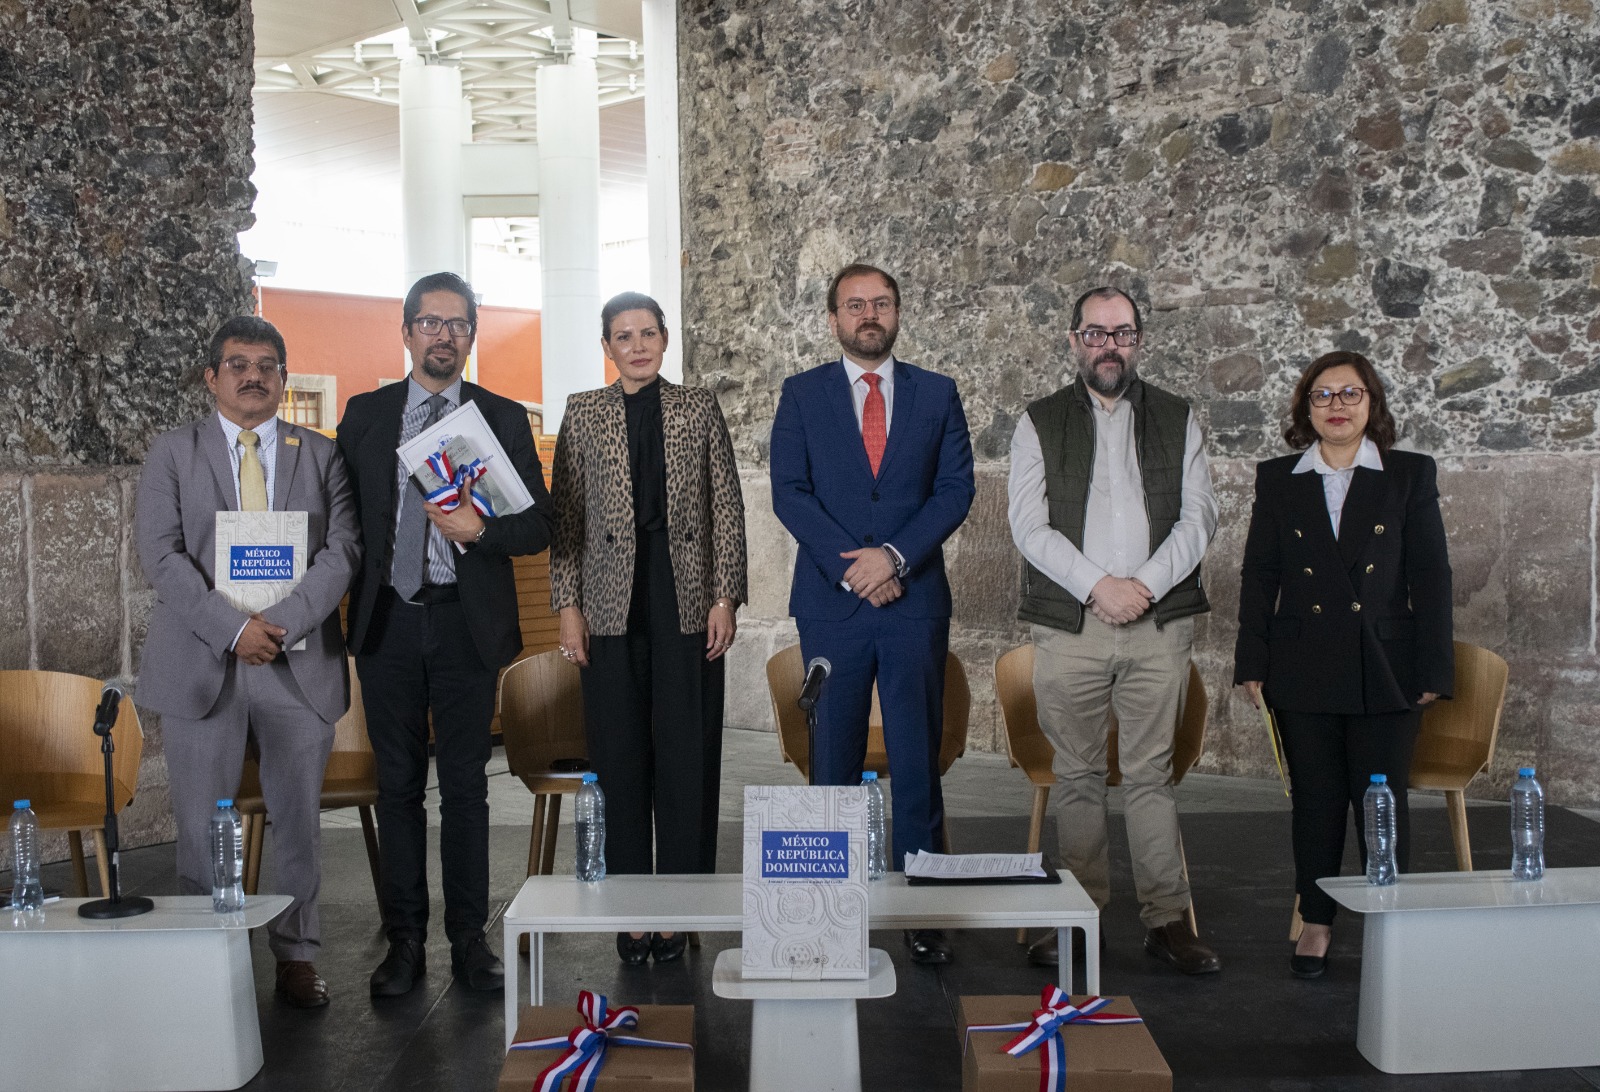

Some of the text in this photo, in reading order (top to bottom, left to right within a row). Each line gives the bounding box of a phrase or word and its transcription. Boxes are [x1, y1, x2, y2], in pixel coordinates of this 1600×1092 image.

[245, 548, 280, 557] MÉXICO
[242, 558, 291, 566] REPÚBLICA
[781, 834, 829, 846] MÉXICO
[766, 847, 845, 859] Y REPÚBLICA
[765, 863, 845, 872] DOMINICANA
